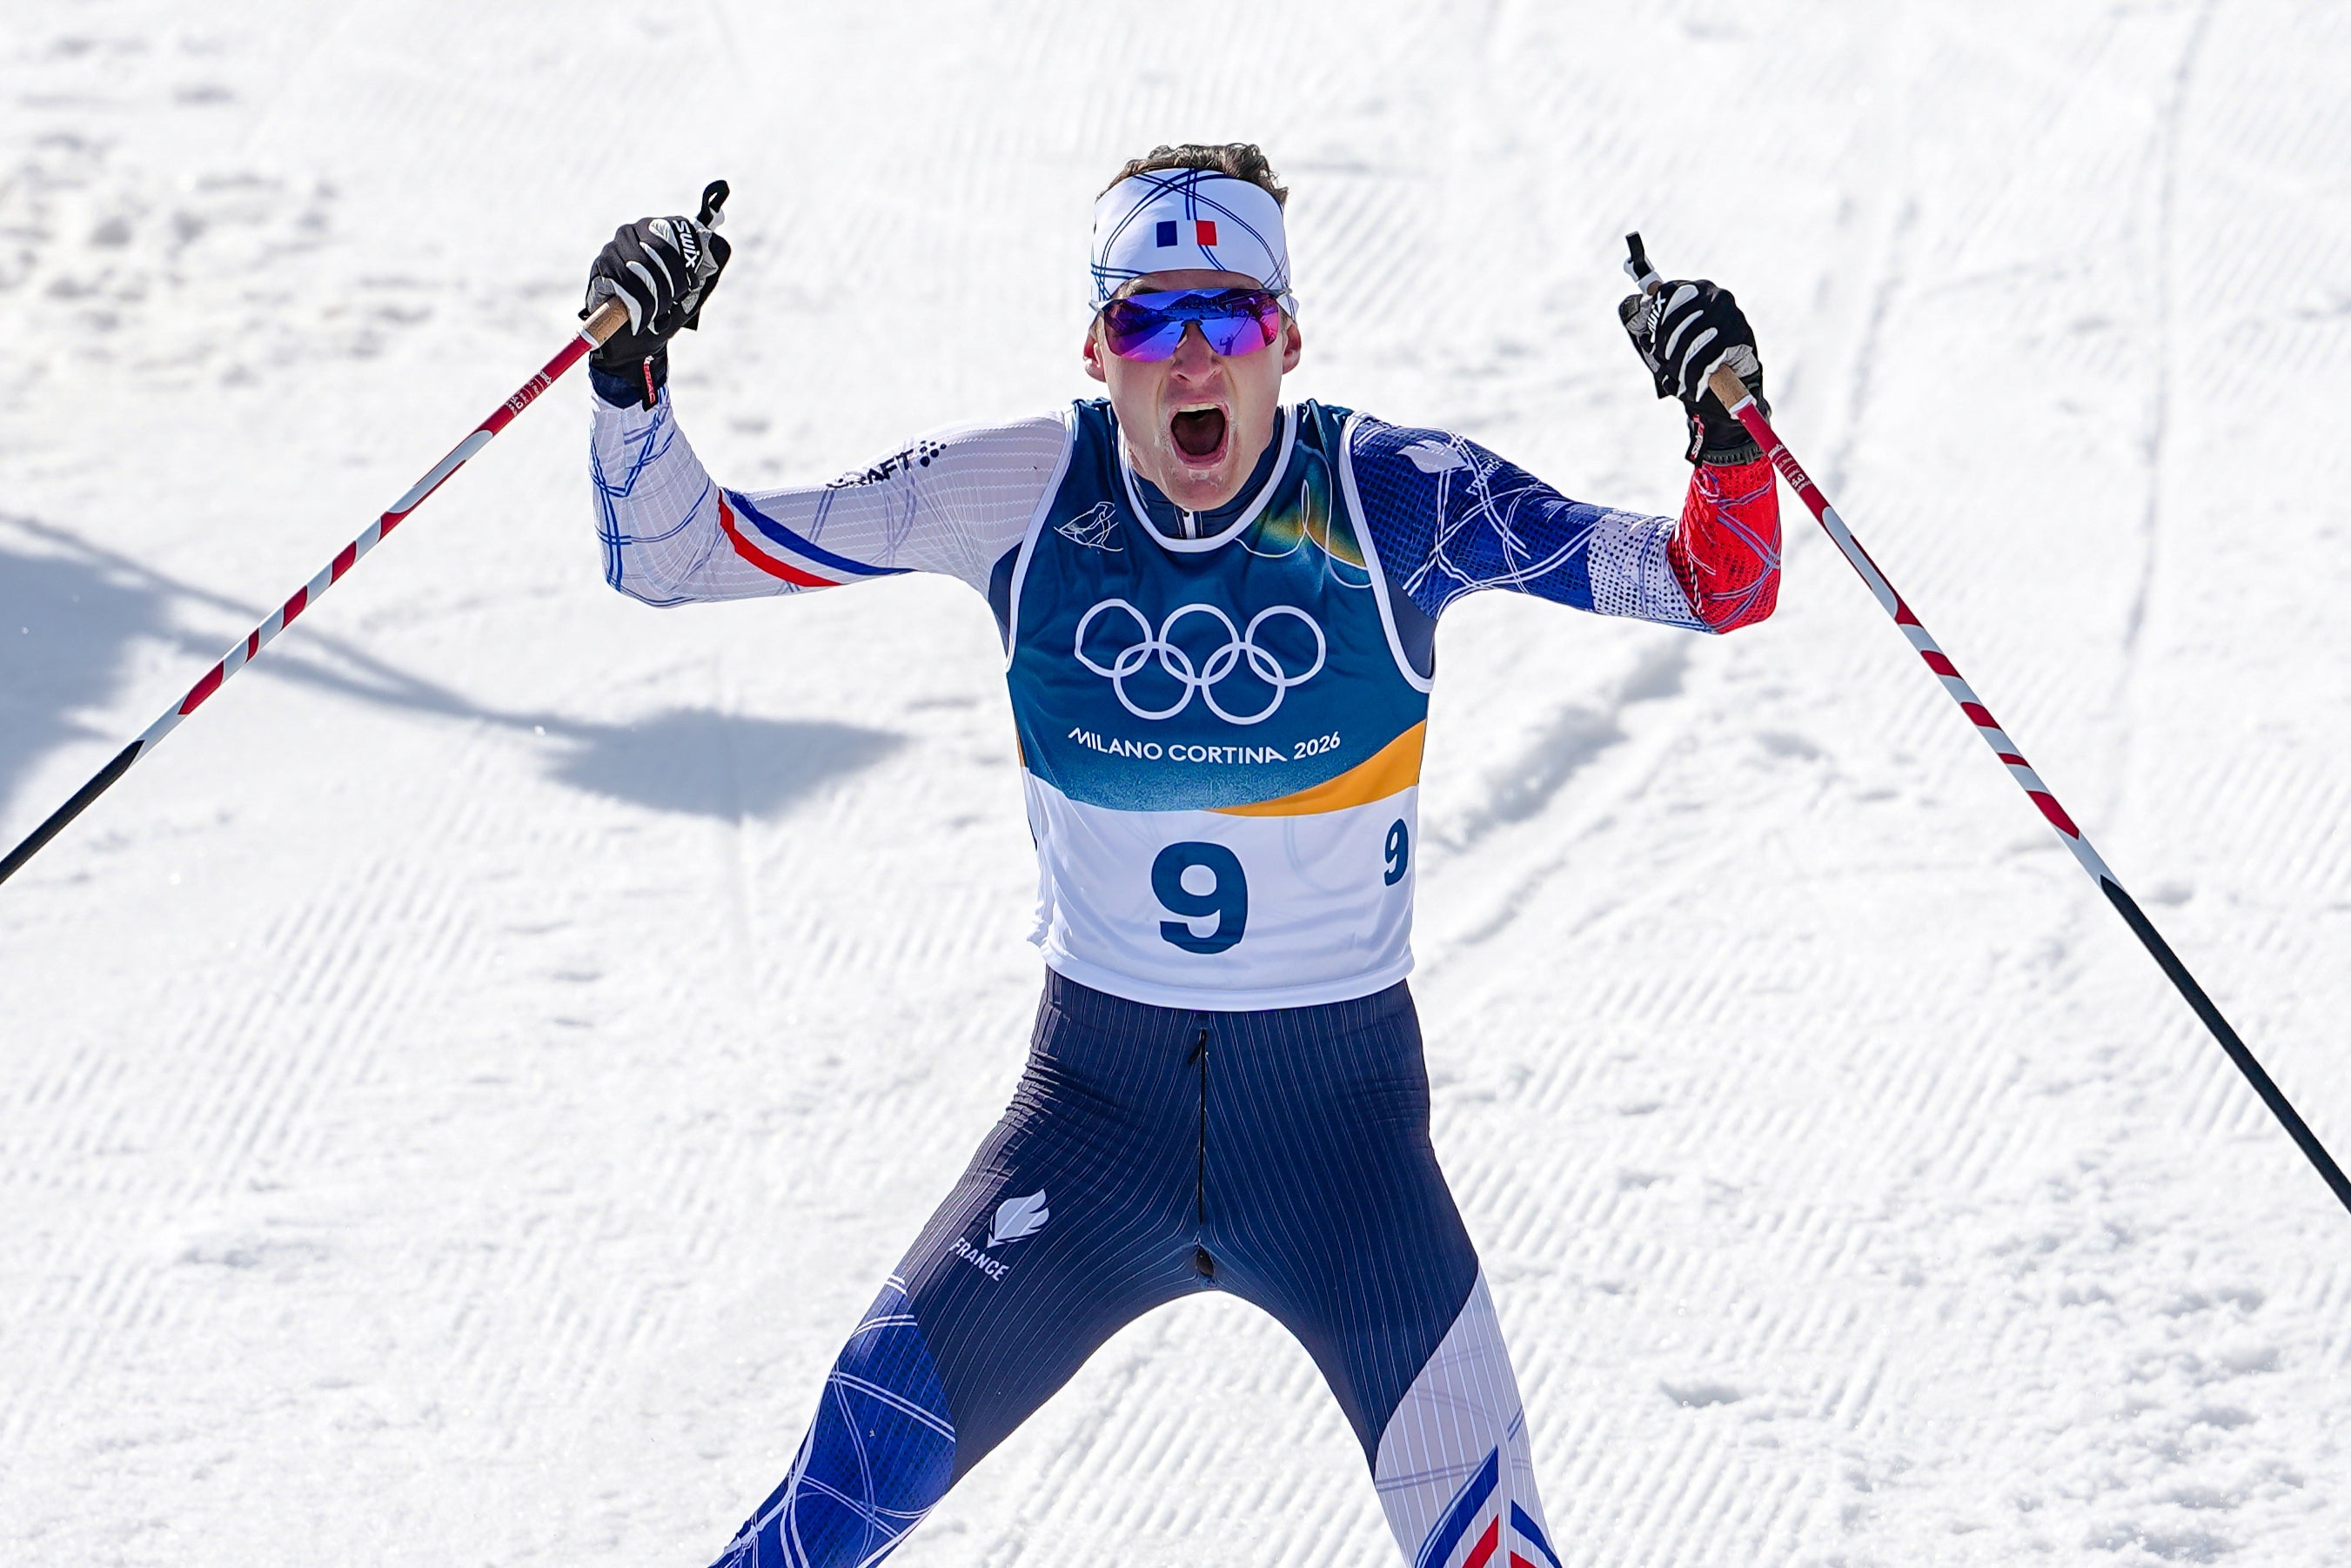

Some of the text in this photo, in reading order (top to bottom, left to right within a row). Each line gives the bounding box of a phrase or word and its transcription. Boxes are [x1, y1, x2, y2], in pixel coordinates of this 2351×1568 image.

[1068, 727, 1342, 765] MILANO CORTINA 2026
[1383, 818, 1409, 887] 9
[1150, 841, 1249, 955] 9
[948, 1236, 1010, 1282] FRANCE
